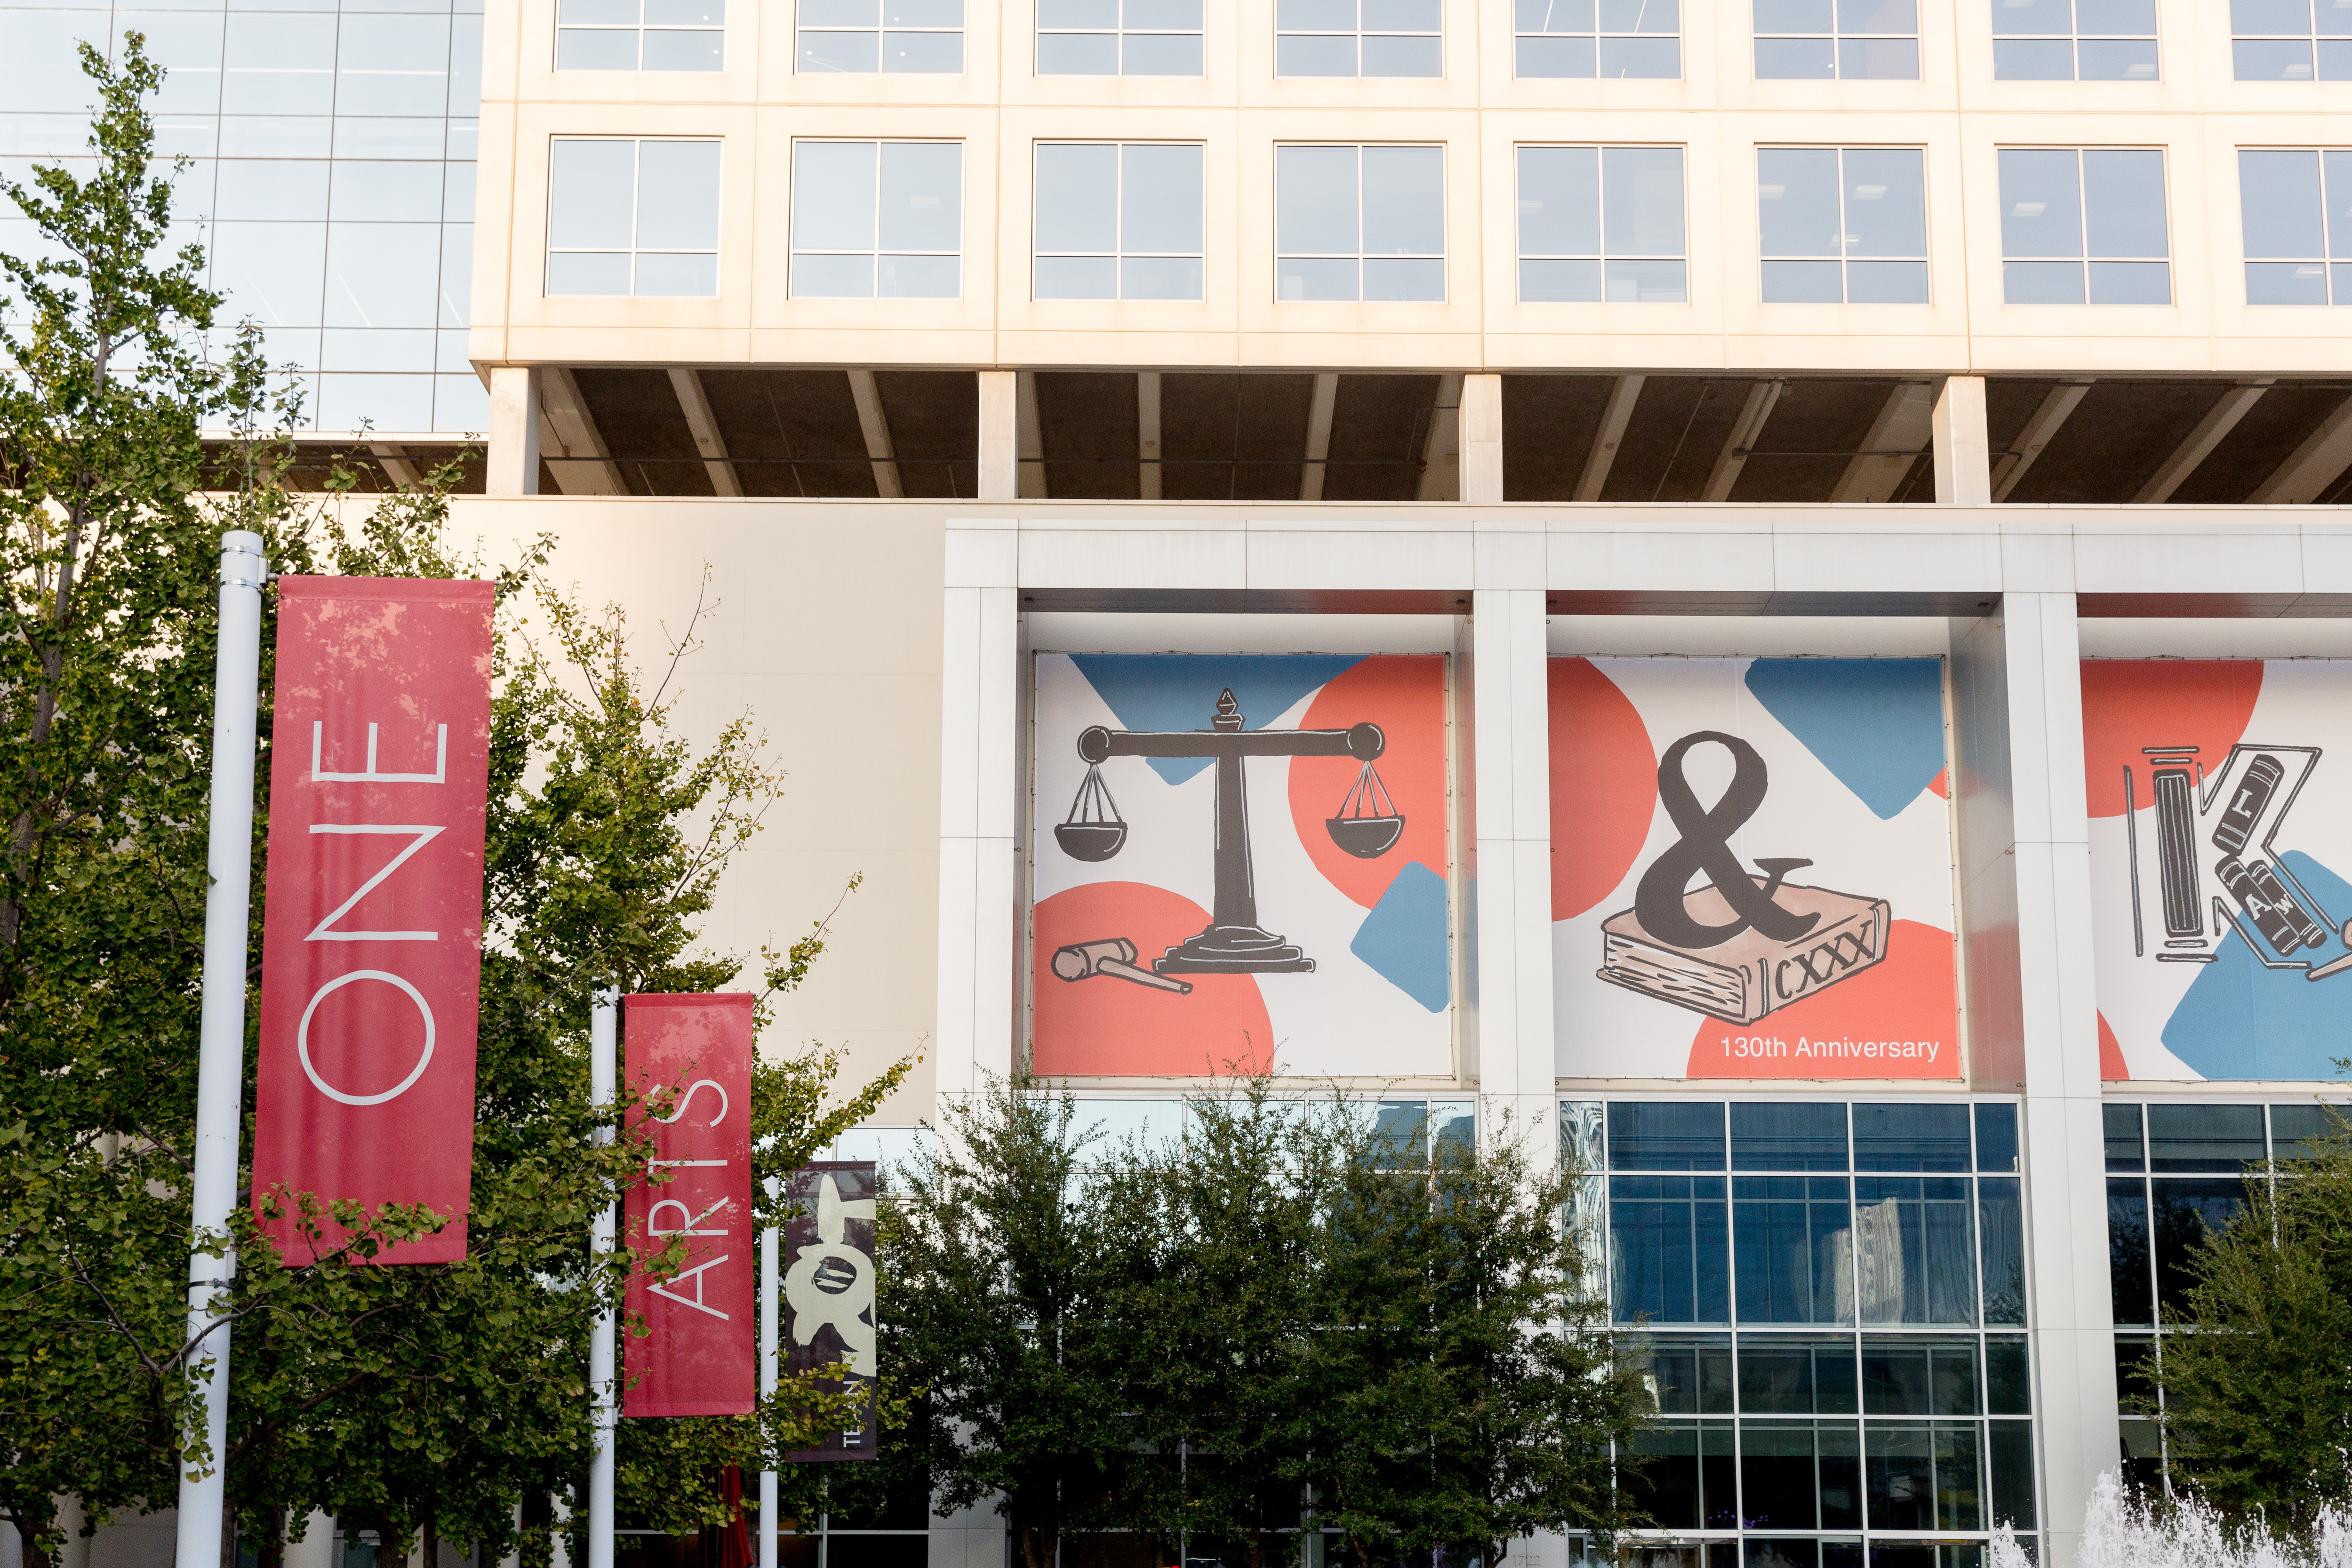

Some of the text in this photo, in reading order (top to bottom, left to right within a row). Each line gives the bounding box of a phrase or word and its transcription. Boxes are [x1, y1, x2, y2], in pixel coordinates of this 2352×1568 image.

[298, 720, 447, 1106] ONE
[1635, 730, 1821, 949] &
[1721, 1036, 1939, 1063] 130th Anniversary
[1775, 919, 1875, 1000] CXXX
[645, 1079, 729, 1321] ARTS
